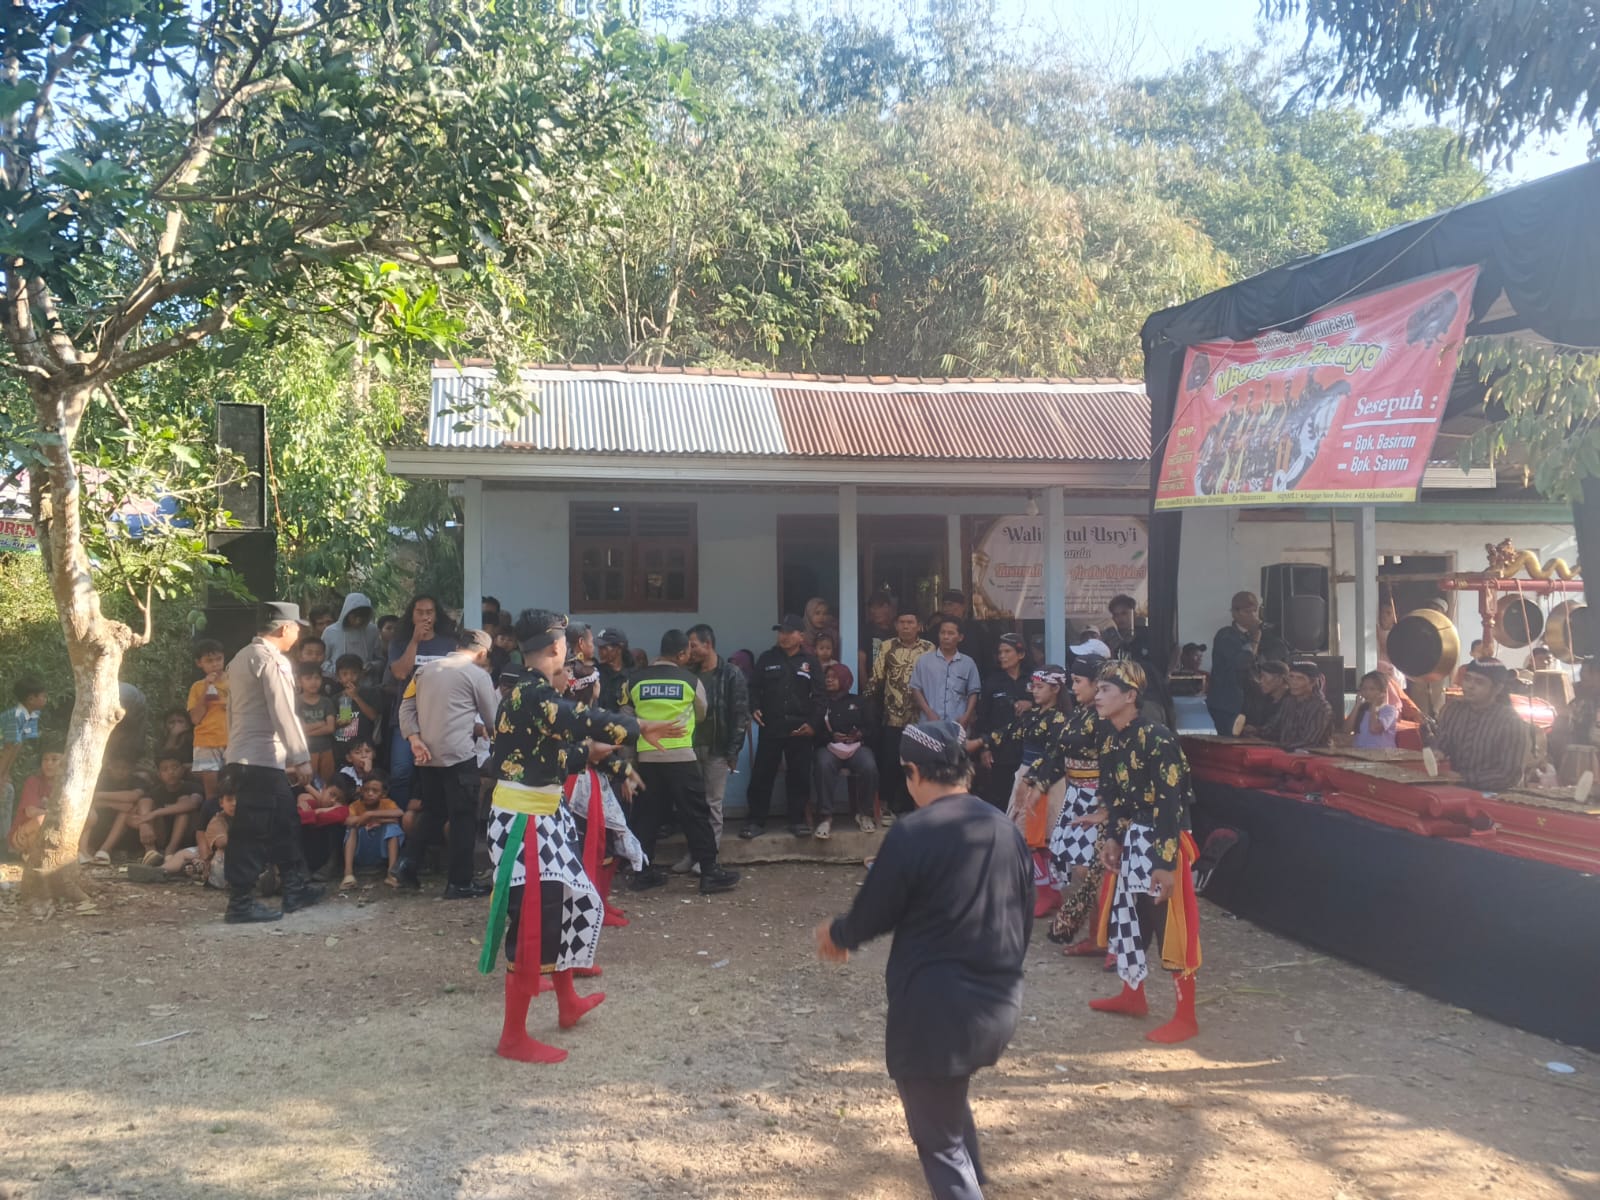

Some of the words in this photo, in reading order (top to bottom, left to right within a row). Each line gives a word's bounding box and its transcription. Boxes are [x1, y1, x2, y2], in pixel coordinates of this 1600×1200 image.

[1354, 388, 1424, 419] Sesepuh
[1376, 432, 1417, 450] Basirun
[1373, 454, 1409, 472] Sawin
[642, 685, 680, 697] POLISI
